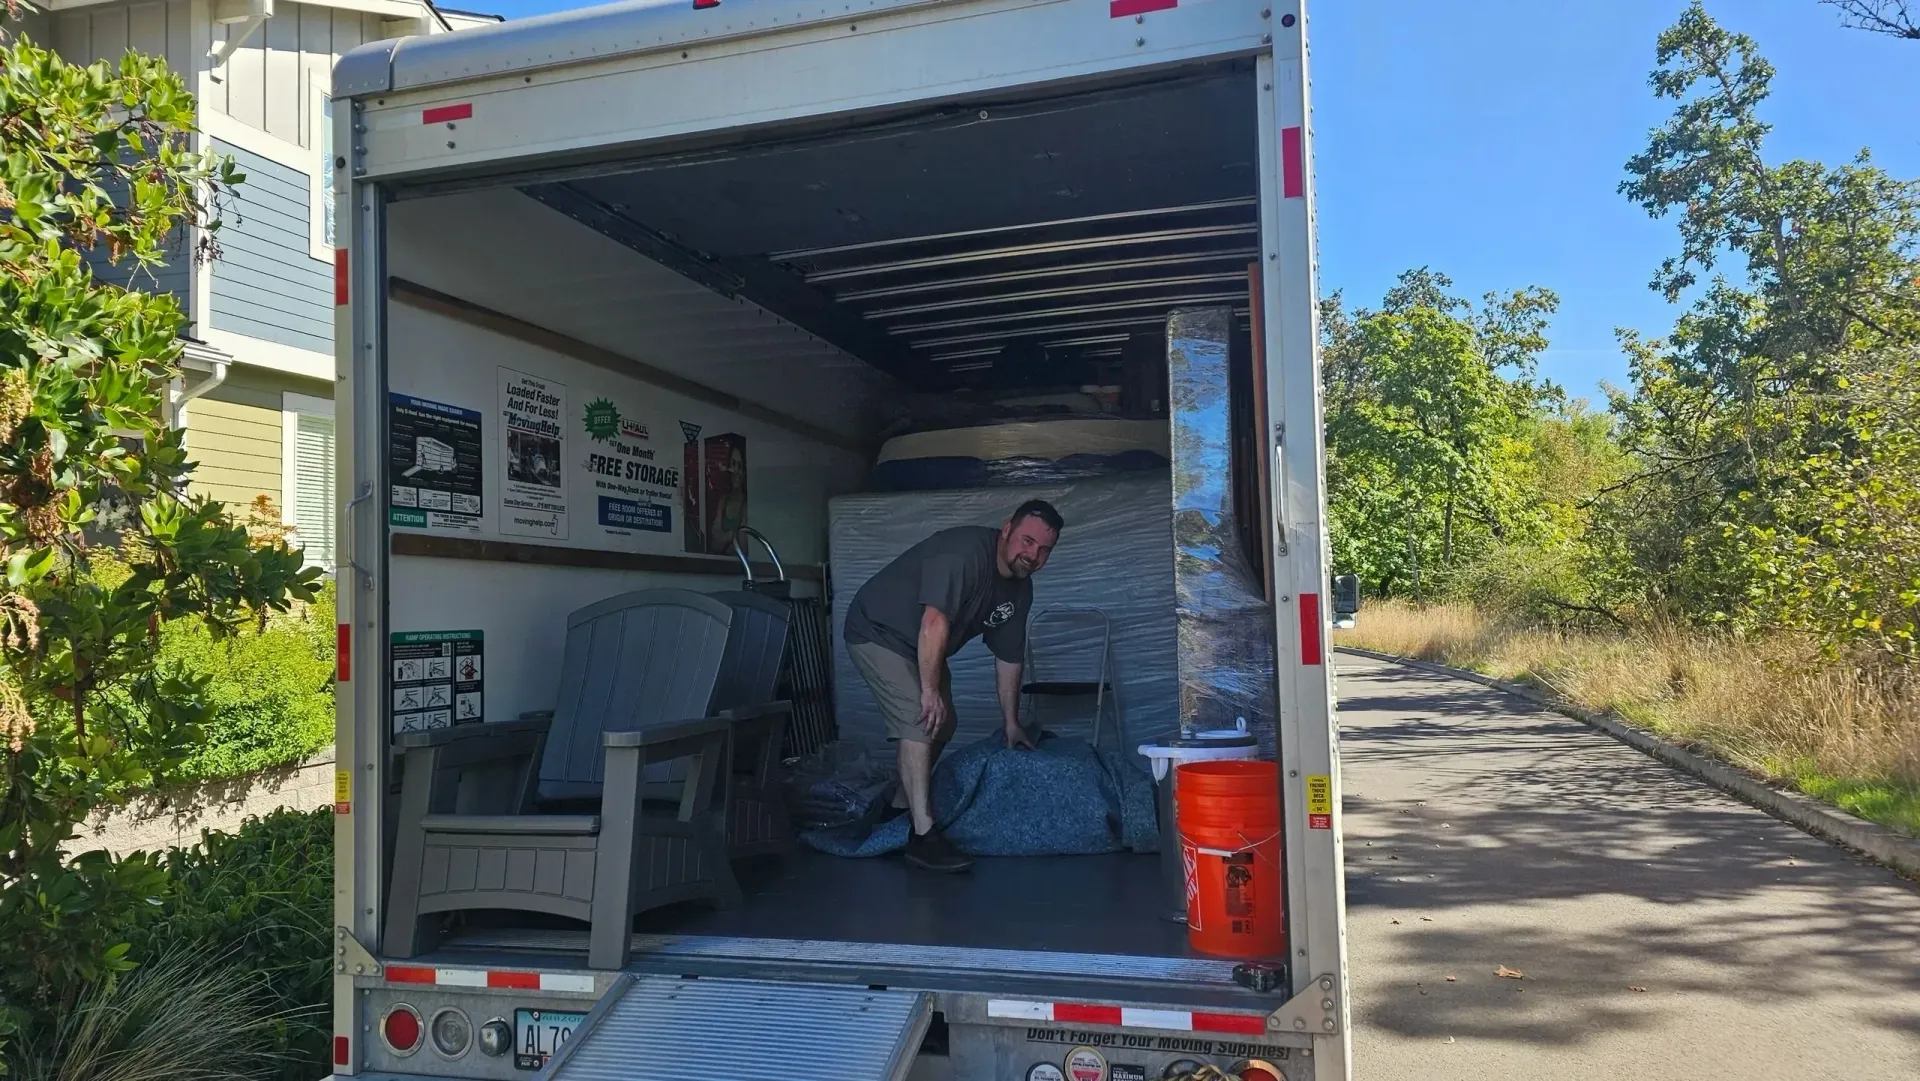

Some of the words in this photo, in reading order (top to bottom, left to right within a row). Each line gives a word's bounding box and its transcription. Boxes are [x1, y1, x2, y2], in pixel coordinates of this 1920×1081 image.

[507, 383, 535, 400] Loaded
[536, 391, 560, 406] Faster
[507, 397, 524, 411] And
[524, 402, 538, 414] For
[539, 405, 559, 420] Less!
[508, 412, 561, 438] MovingHelp
[594, 415, 611, 425] OFFER
[617, 442, 630, 455] One
[589, 453, 623, 477] FREE
[626, 461, 679, 488] STORAGE
[393, 513, 424, 523] ATTENTION
[608, 502, 621, 512] FREE
[622, 505, 636, 513] ROOM
[637, 507, 656, 517] OFFERED
[657, 509, 663, 517] AT
[514, 518, 555, 527] movinghelp.com
[1026, 1028, 1065, 1042] Don't
[1069, 1031, 1116, 1047] Forget
[1120, 1034, 1153, 1048] Your
[1157, 1037, 1212, 1054] Moving
[1217, 1041, 1290, 1059] Supplies!
